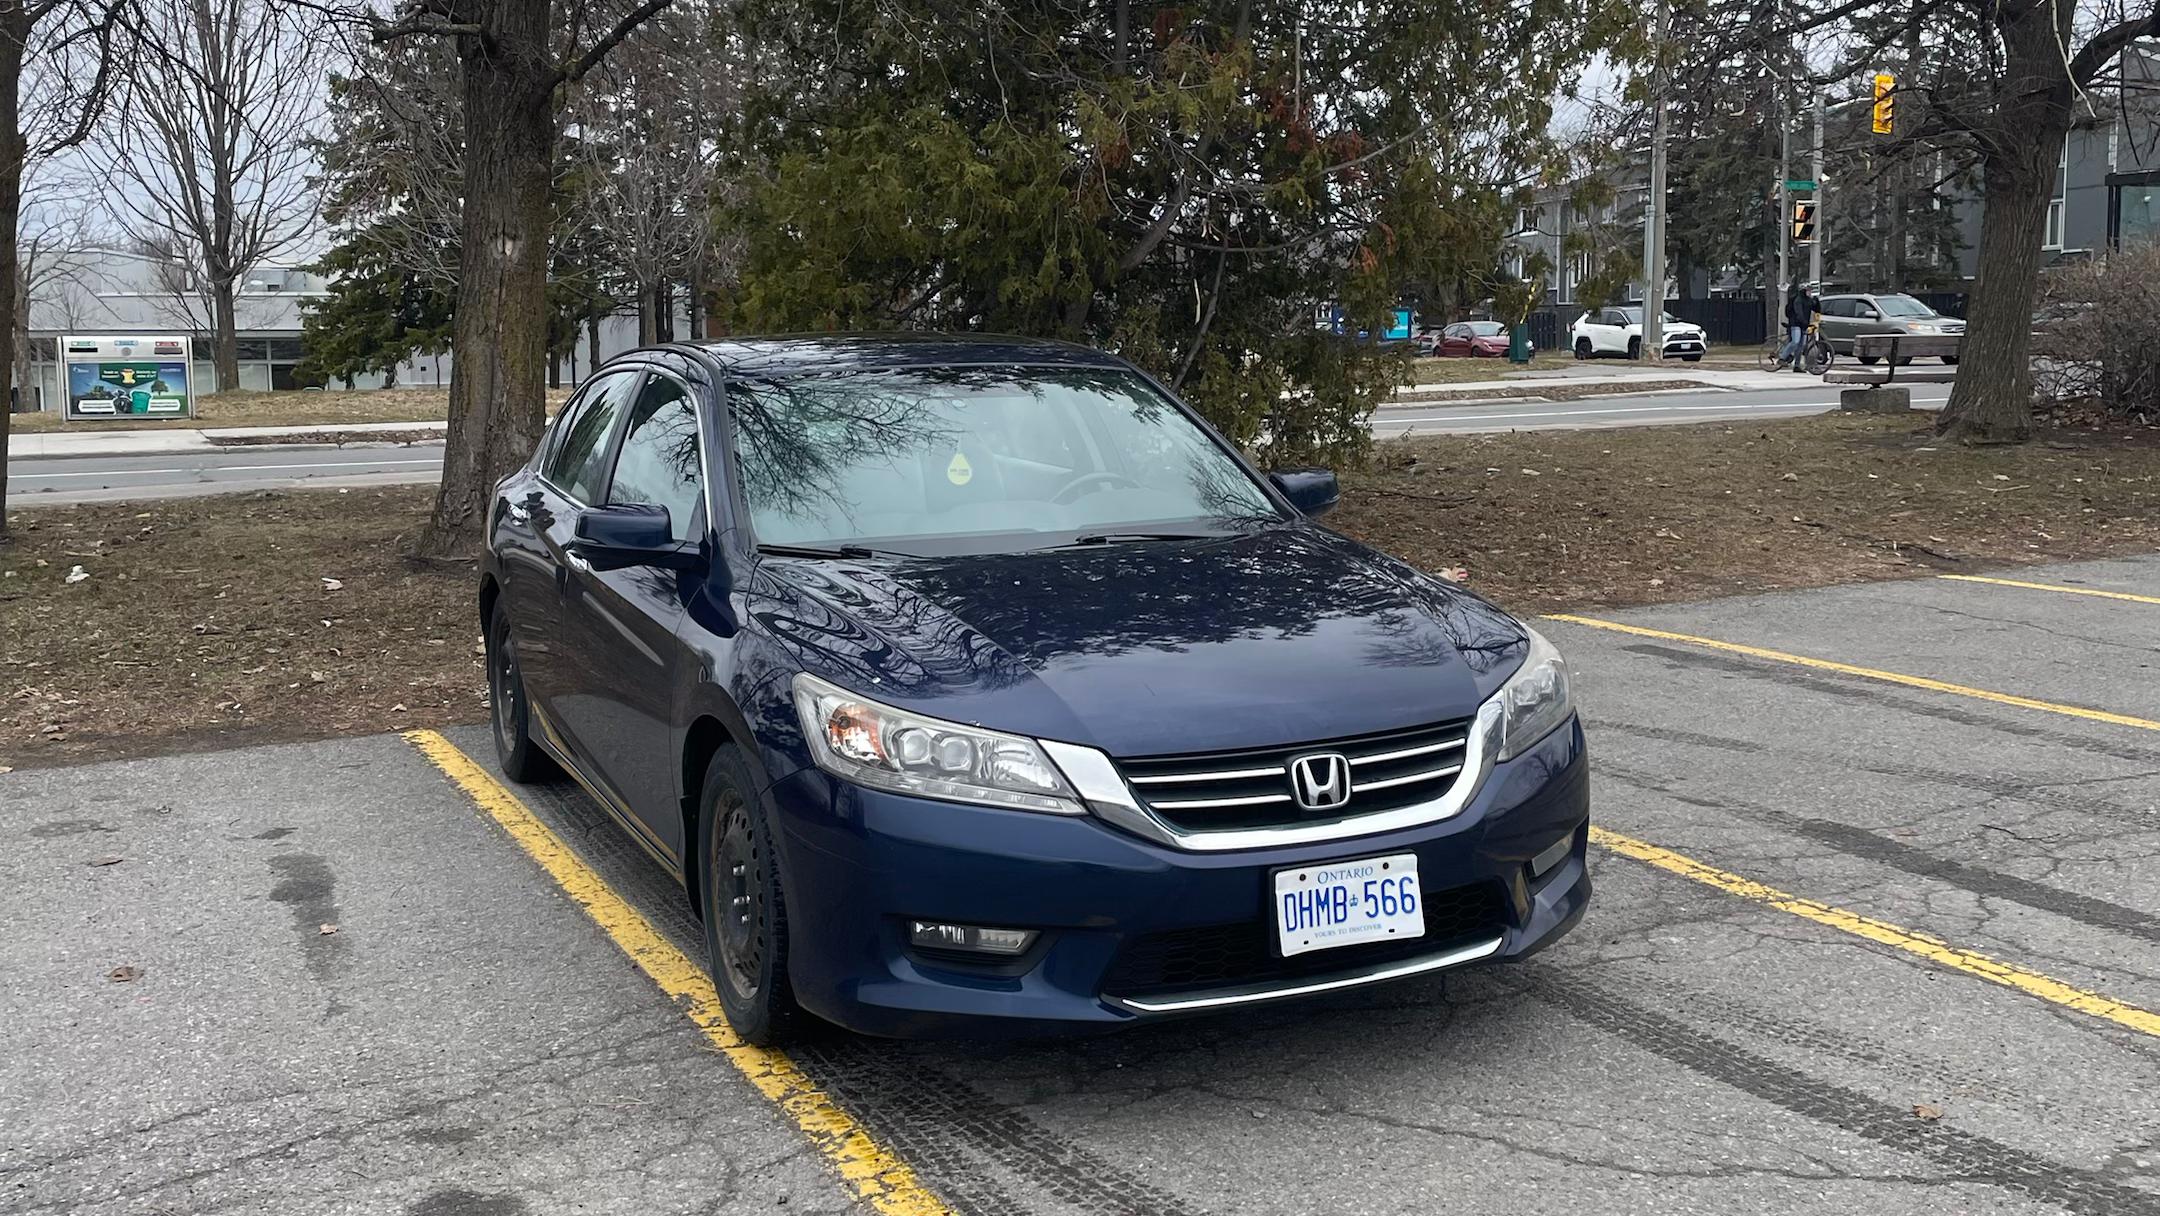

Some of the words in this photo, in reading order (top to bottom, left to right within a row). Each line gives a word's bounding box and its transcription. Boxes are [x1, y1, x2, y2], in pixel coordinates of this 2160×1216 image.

[1317, 866, 1374, 885] ONTARIO
[1284, 885, 1348, 932] DHMB
[1364, 876, 1416, 918] 566
[1314, 930, 1336, 939] YOURS
[1349, 923, 1382, 934] DISCOVER
